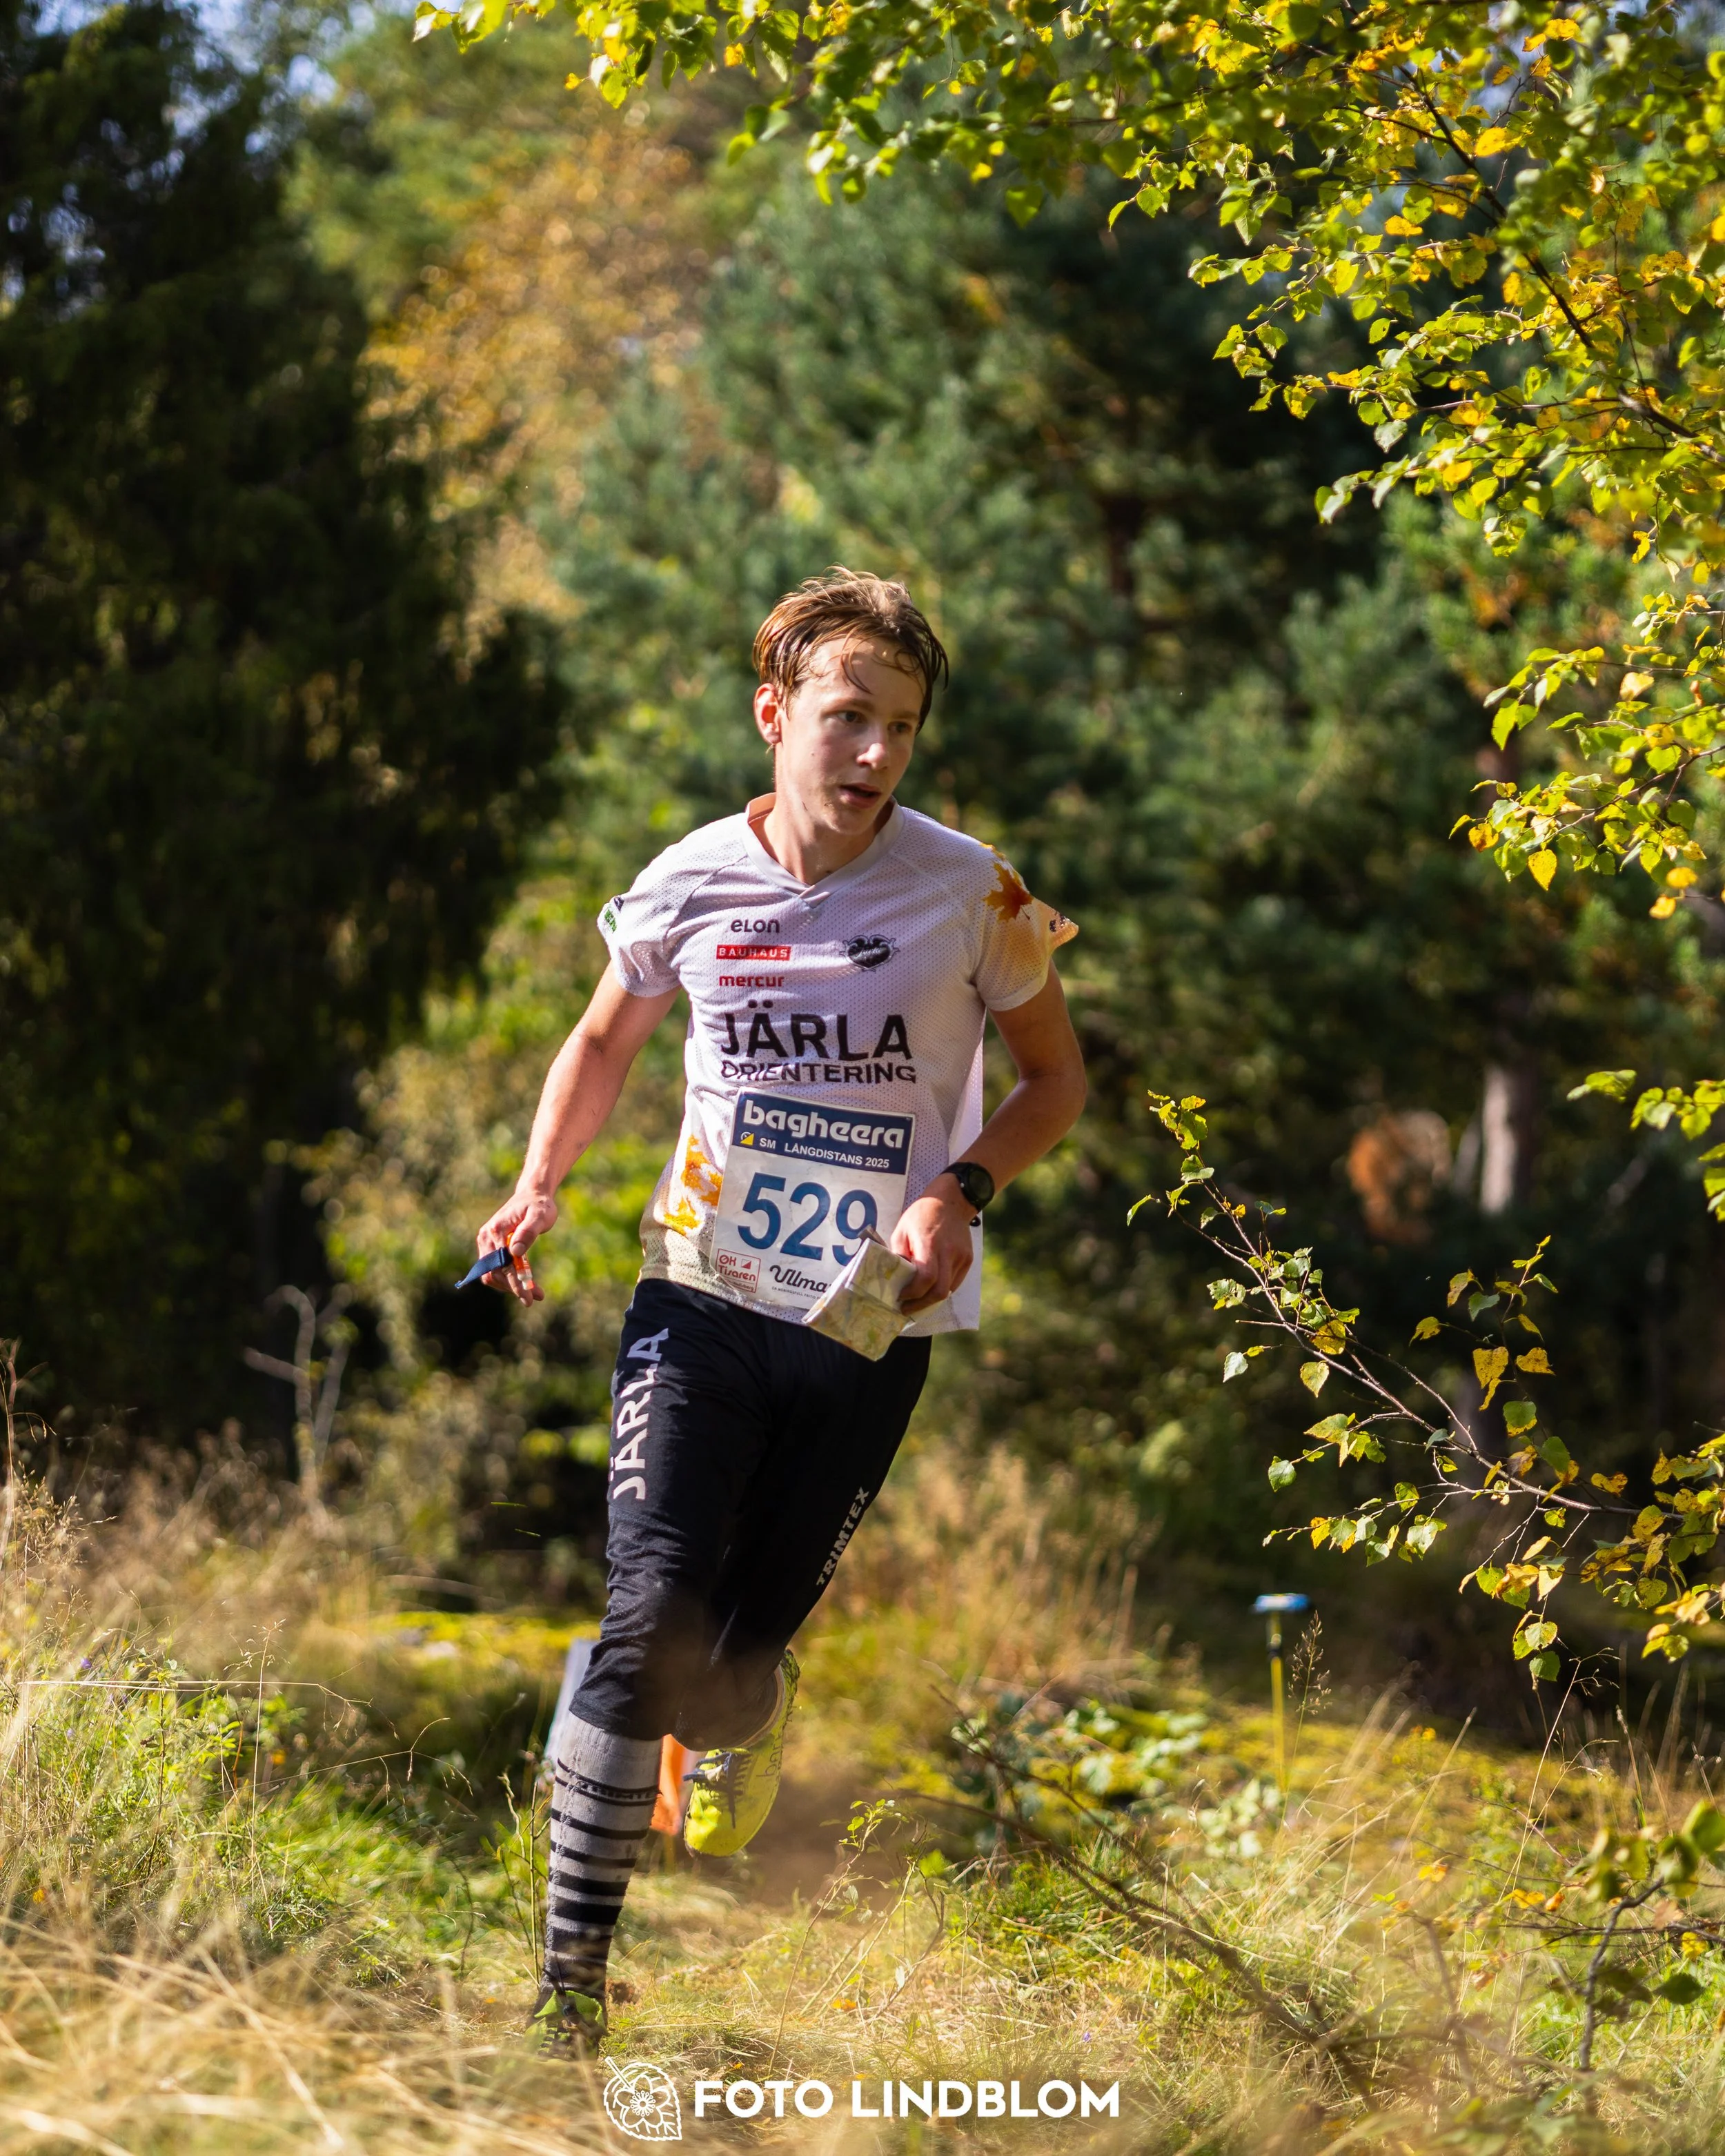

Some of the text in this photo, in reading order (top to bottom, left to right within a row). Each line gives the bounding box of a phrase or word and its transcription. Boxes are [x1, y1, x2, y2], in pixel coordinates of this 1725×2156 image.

[718, 947, 789, 958] BAUHAUS
[718, 976, 785, 987] mercur
[721, 1000, 912, 1061] JÄRLA
[721, 1059, 916, 1084] ORIENTERING
[743, 1100, 905, 1149] bagheera
[759, 1138, 776, 1149] SM
[865, 1157, 890, 1168] 2025
[738, 1171, 878, 1267] 529
[718, 1265, 756, 1281] Tisaren
[769, 1265, 831, 1293] Ullma
[610, 1328, 669, 1500] JÄRLA
[816, 1486, 869, 1585] TRIMTEX
